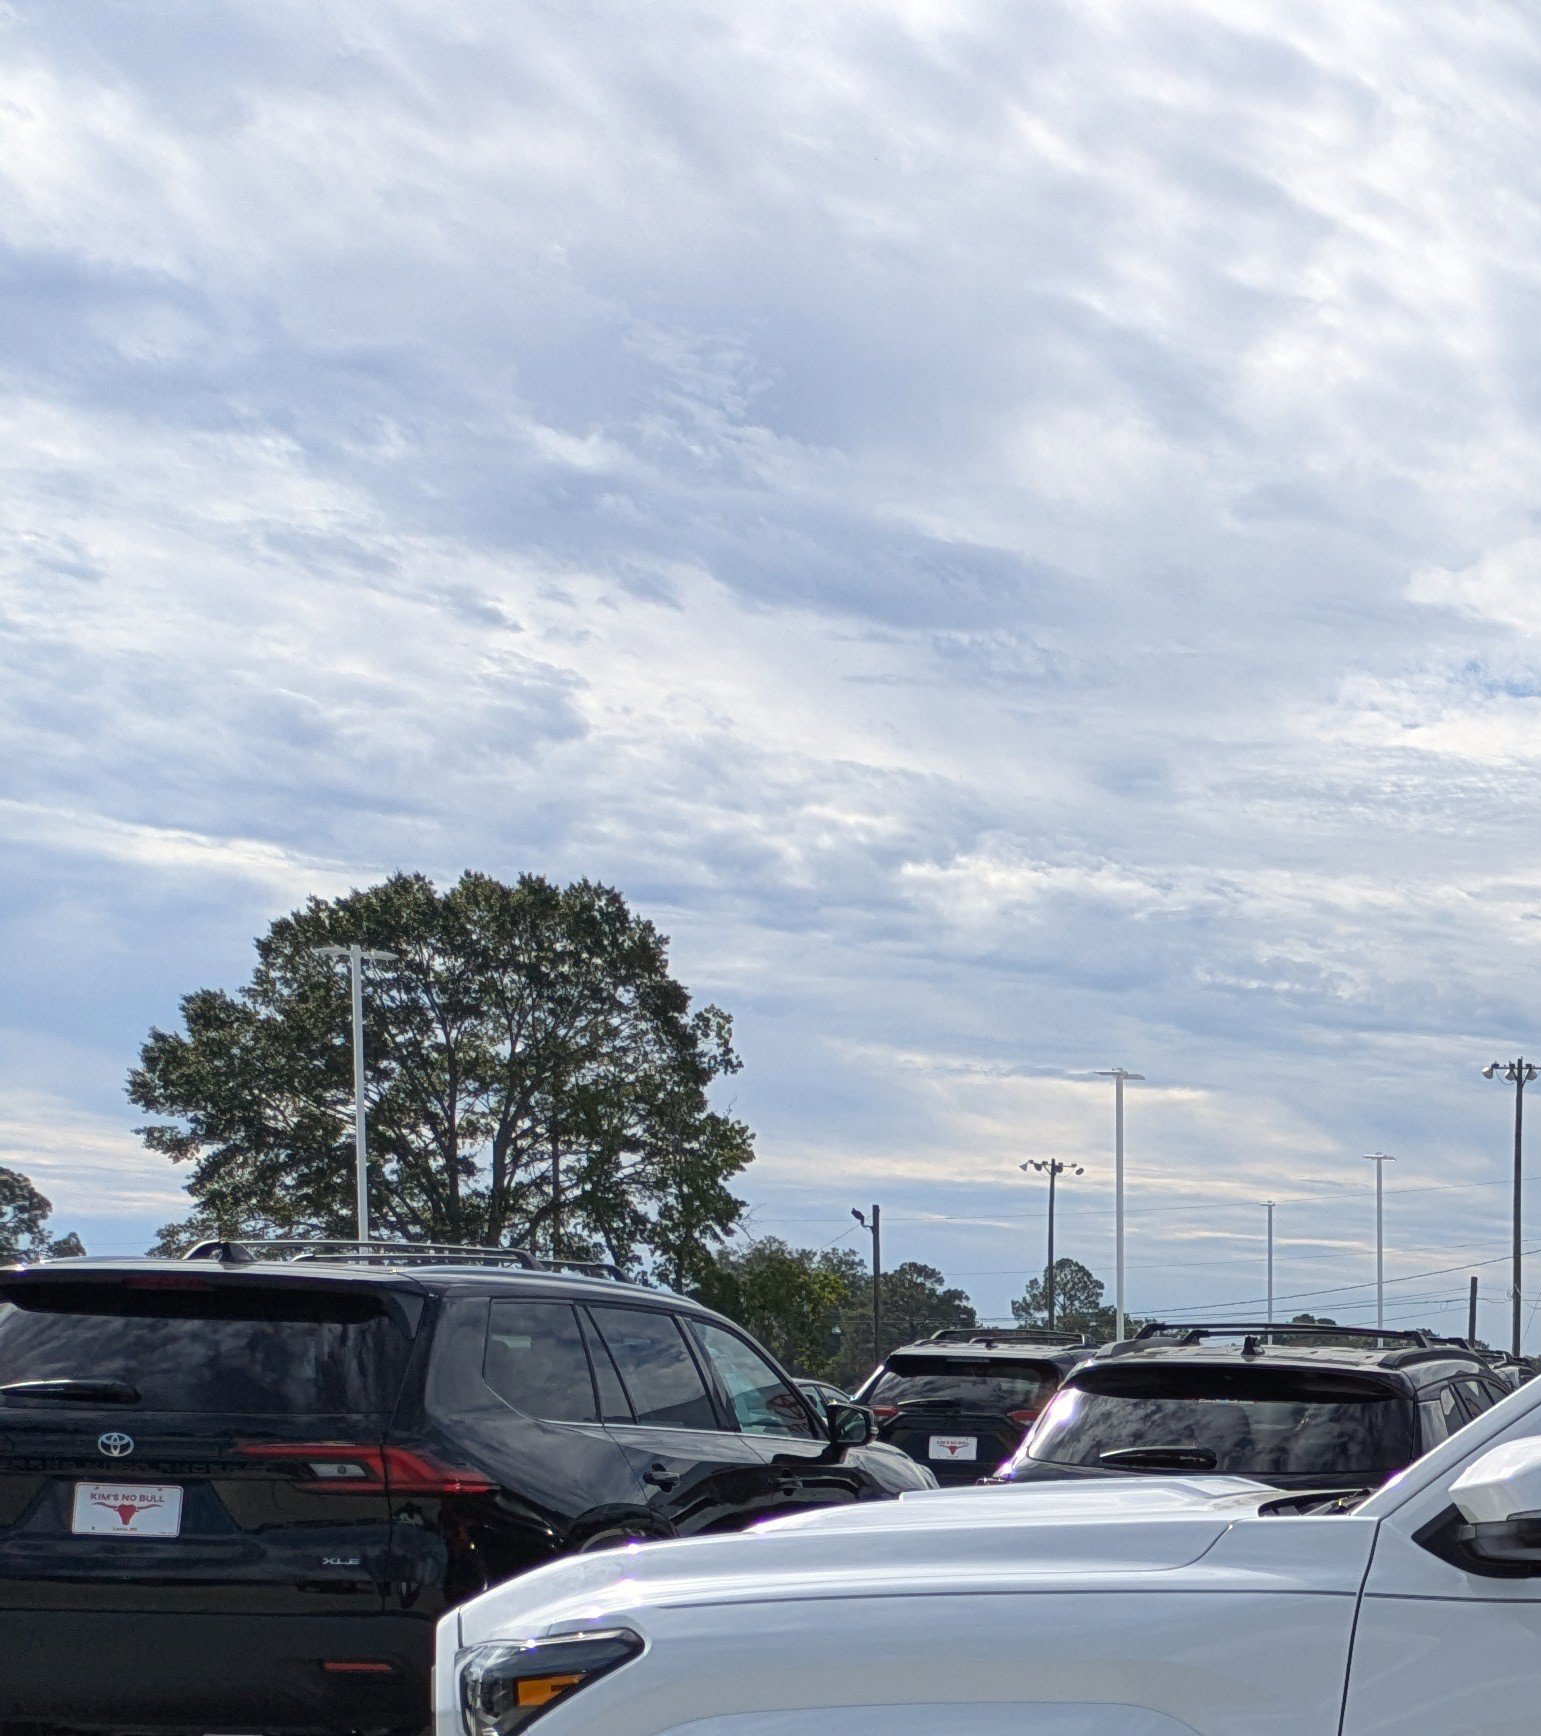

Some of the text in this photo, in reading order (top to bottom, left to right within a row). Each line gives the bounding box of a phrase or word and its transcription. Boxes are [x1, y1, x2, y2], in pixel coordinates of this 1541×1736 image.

[90, 1492, 165, 1503] KIM'S NO BULL
[321, 1557, 360, 1565] XLE
